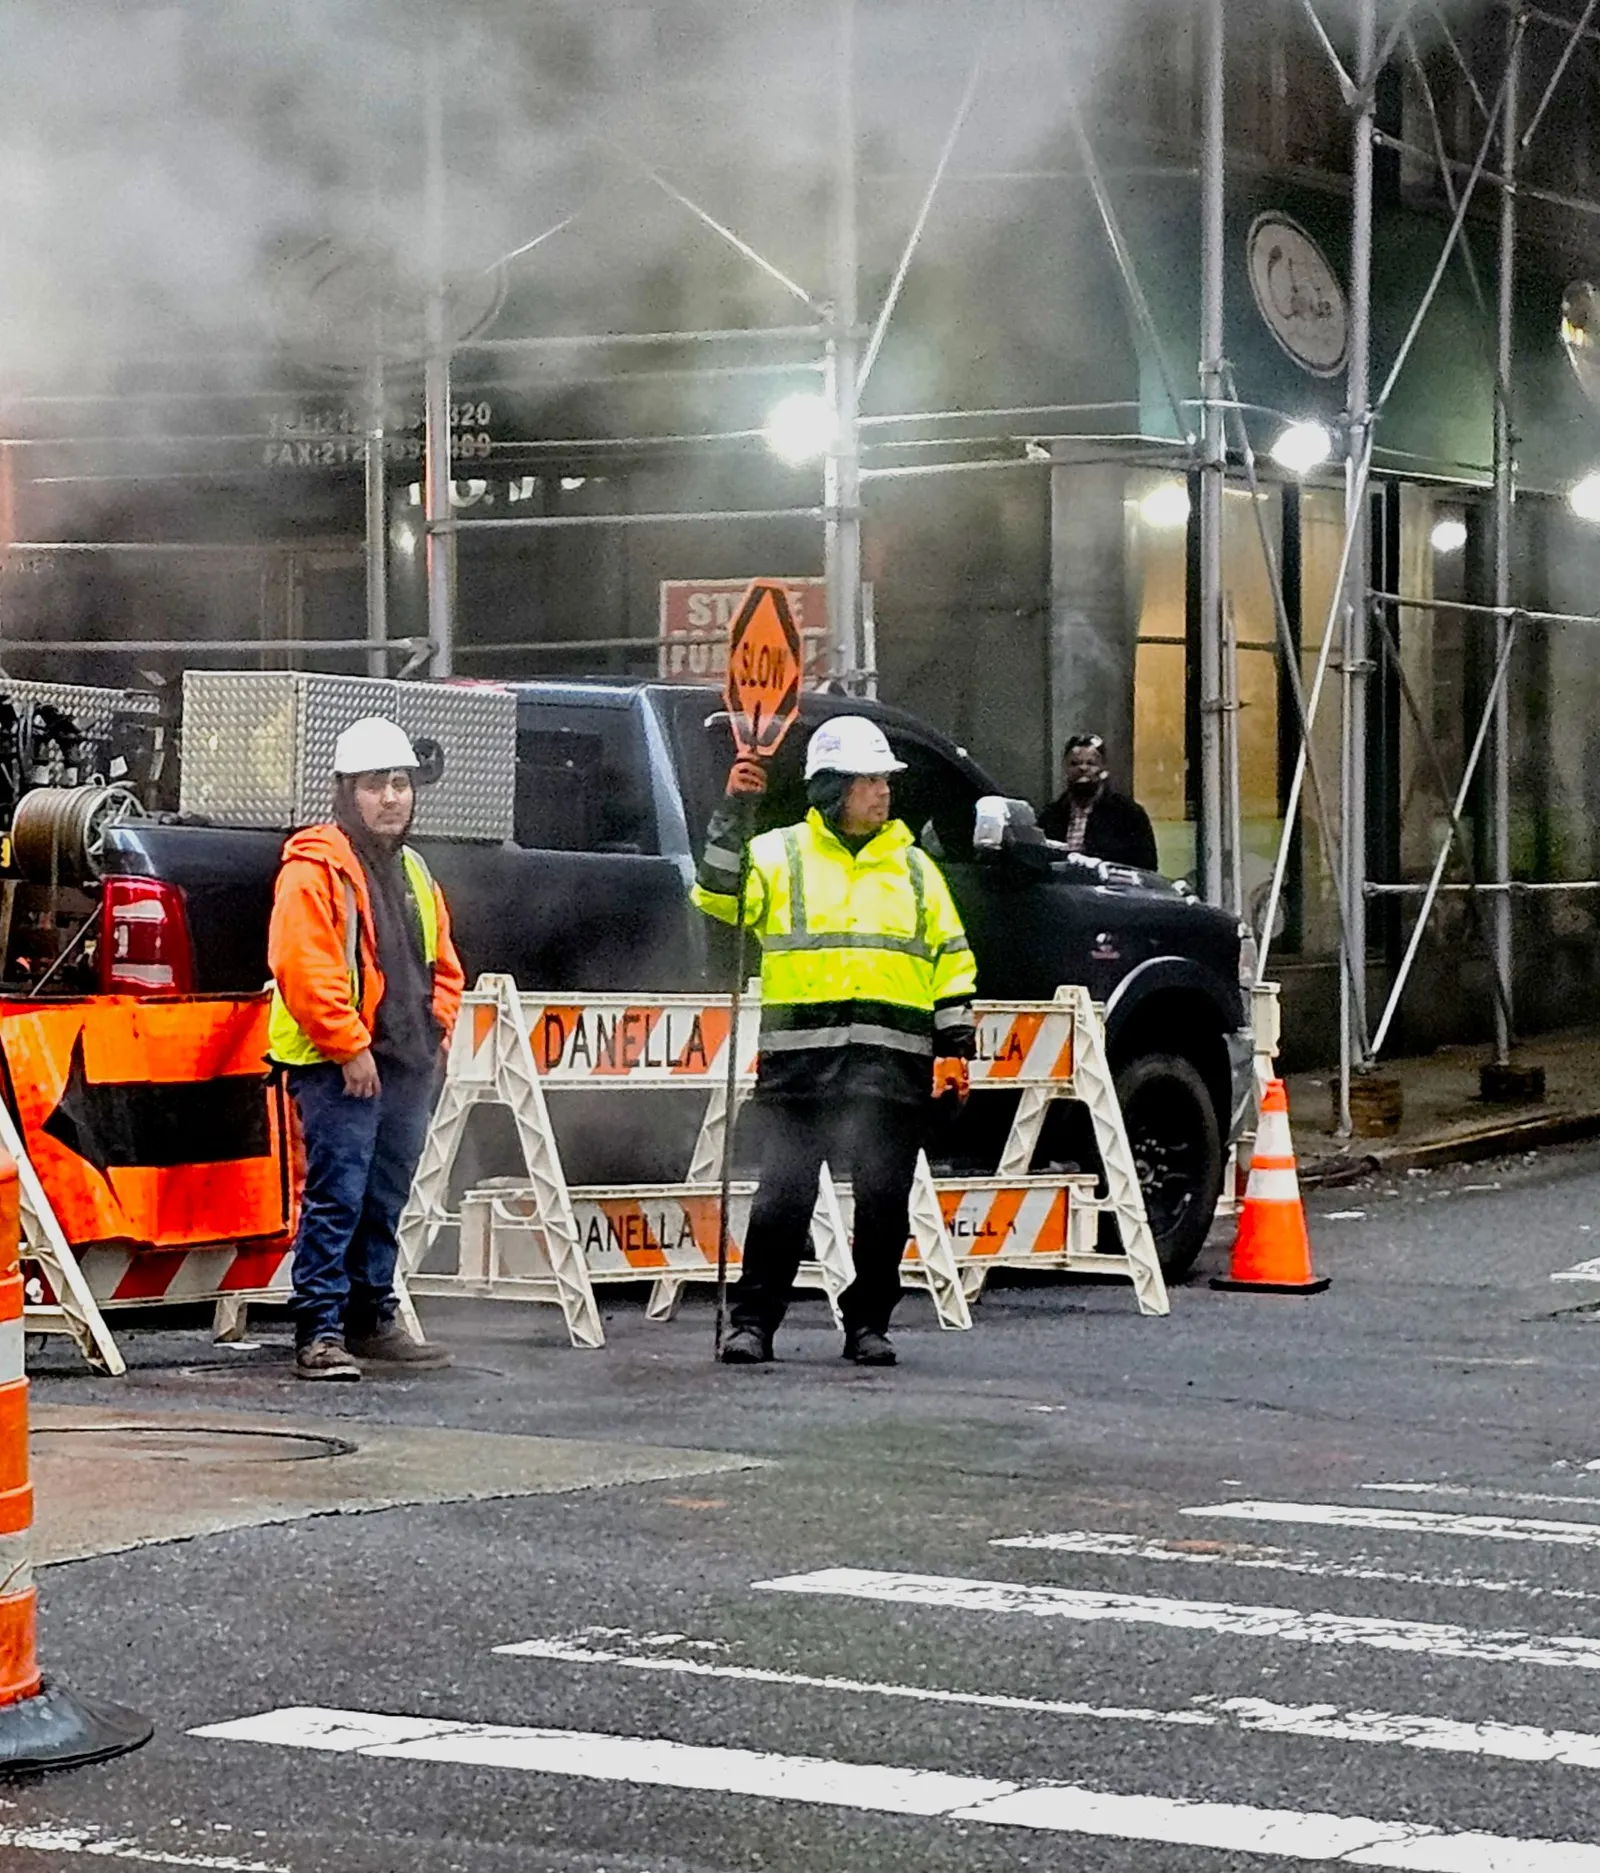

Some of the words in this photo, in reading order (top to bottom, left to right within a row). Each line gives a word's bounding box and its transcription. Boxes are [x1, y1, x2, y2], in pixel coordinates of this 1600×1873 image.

[687, 591, 804, 627] STE
[741, 642, 787, 691] SLOW
[543, 1012, 709, 1069] DANELLA
[971, 1026, 1024, 1062] LLA
